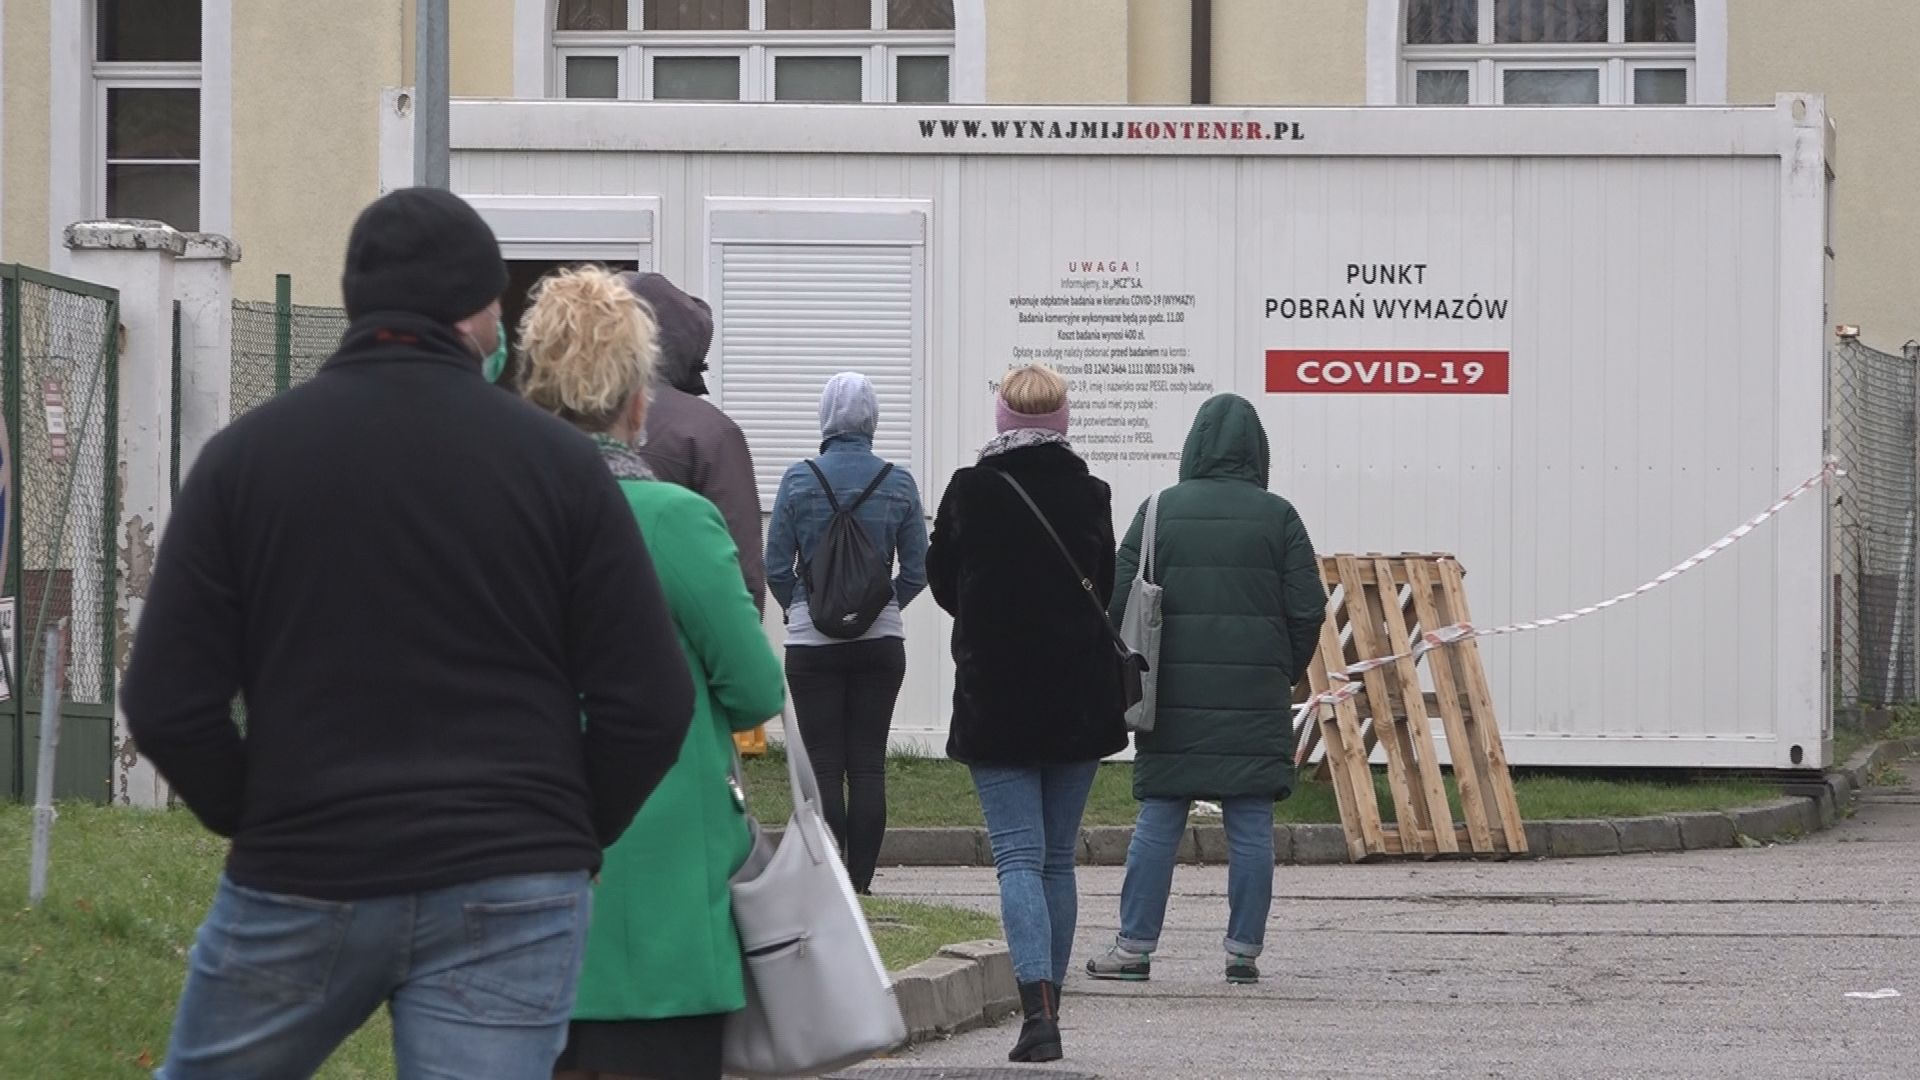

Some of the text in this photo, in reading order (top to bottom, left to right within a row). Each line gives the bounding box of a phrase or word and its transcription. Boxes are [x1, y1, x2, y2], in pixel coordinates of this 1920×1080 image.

[918, 119, 1306, 141] WWW.WYNAJMIJKONTENER.PL
[1346, 264, 1427, 285] PUNKT
[1009, 295, 1039, 308] wykonuje
[1070, 295, 1095, 306] badania
[1103, 295, 1130, 306] kierunku
[1131, 295, 1161, 306] COVID-19
[1162, 295, 1195, 308] (WYMAZY)
[1265, 292, 1509, 319] POBRAŃ WYMAZÓW
[1019, 312, 1043, 322] Badania
[1045, 312, 1080, 326] komercyjne
[1081, 312, 1121, 326] wykonywane
[1122, 312, 1138, 325] będą
[1139, 314, 1147, 325] po
[1166, 312, 1184, 322] 11.00
[1057, 330, 1075, 340] Koszt
[1076, 330, 1100, 340] badania
[1101, 330, 1123, 343] wynosi
[1124, 330, 1137, 340] 400
[1110, 346, 1128, 359] przed
[1129, 346, 1159, 356] badaniem
[1084, 363, 1093, 374] 03
[1094, 363, 1110, 374] 1240
[1128, 363, 1144, 374] 1111
[1144, 363, 1161, 374] 0010
[1296, 360, 1486, 385] COVID-19
[1150, 380, 1168, 391] PESEL
[1169, 382, 1187, 394] osoby
[1134, 432, 1153, 443] PESEL
